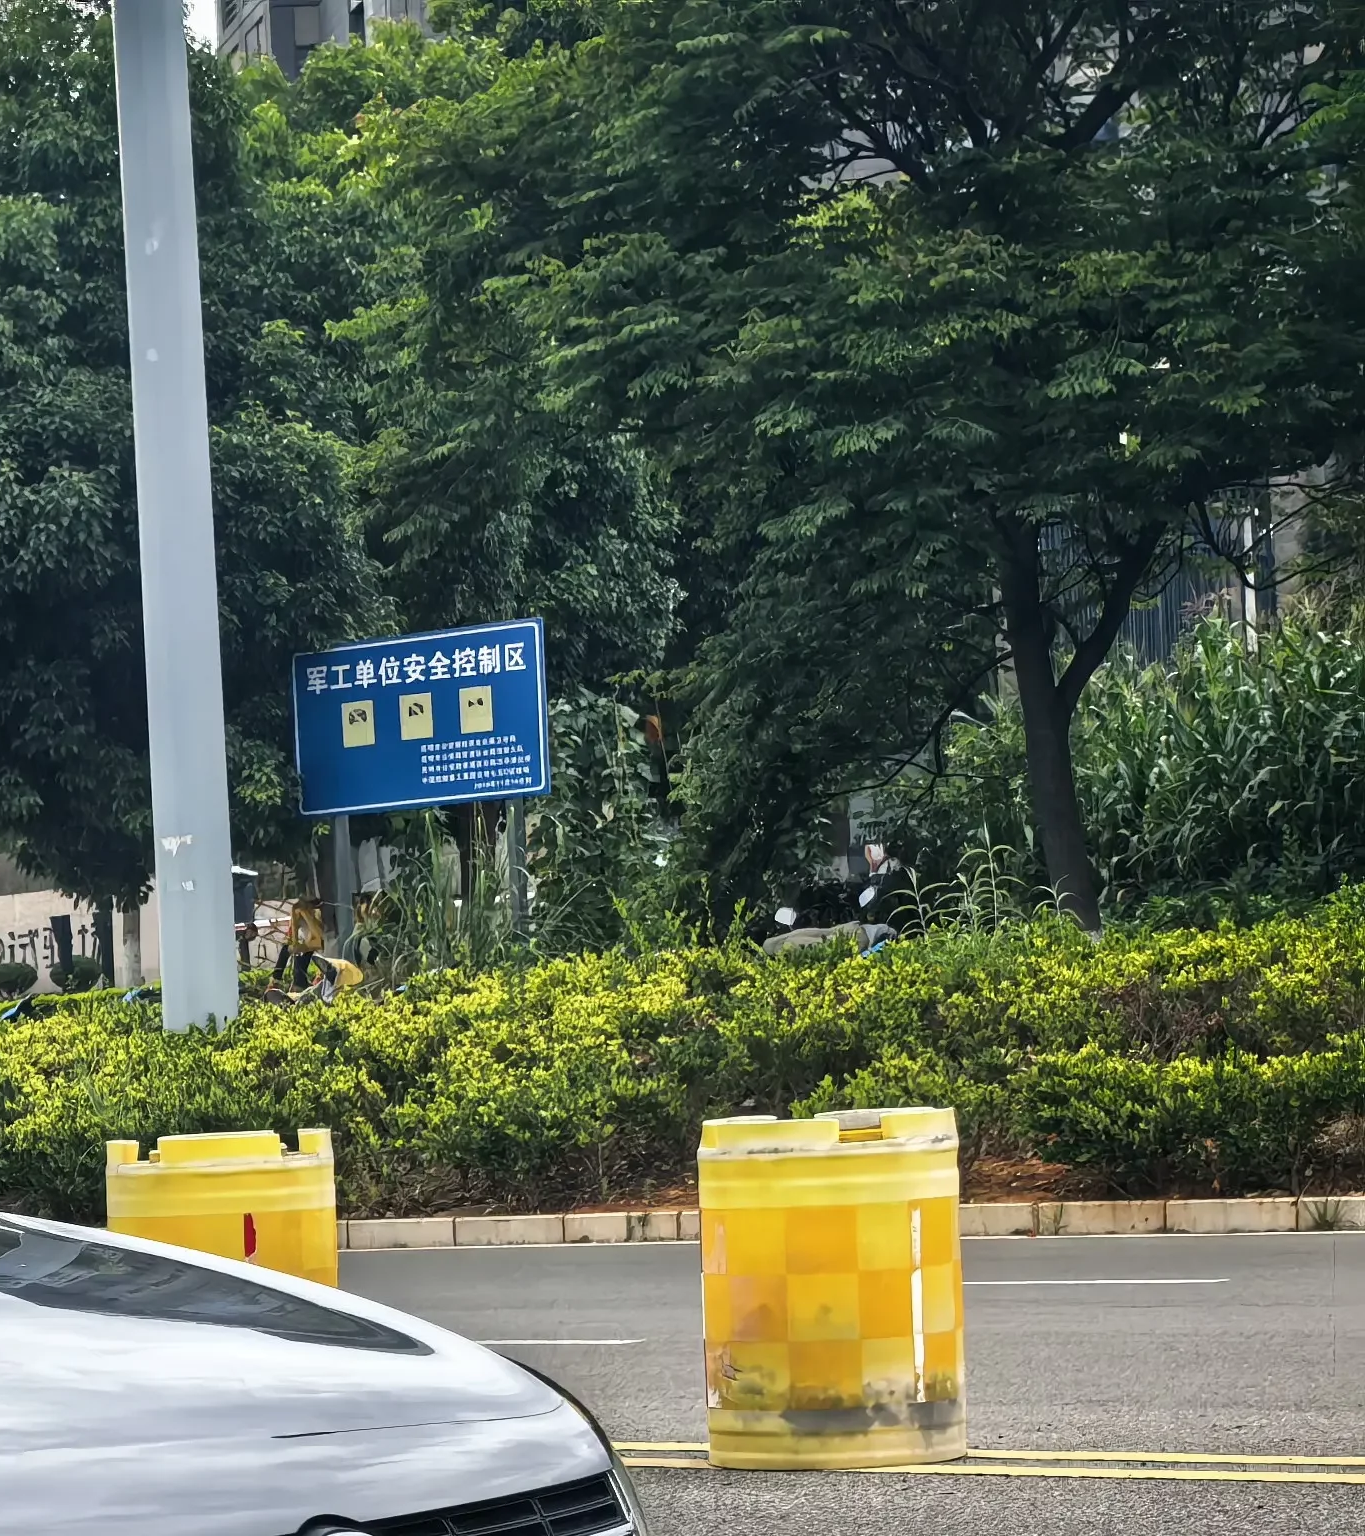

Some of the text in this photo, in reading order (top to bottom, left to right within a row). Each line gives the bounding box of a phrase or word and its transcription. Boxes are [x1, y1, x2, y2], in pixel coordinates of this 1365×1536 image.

[306, 642, 527, 695] 军工单位安全控制区
